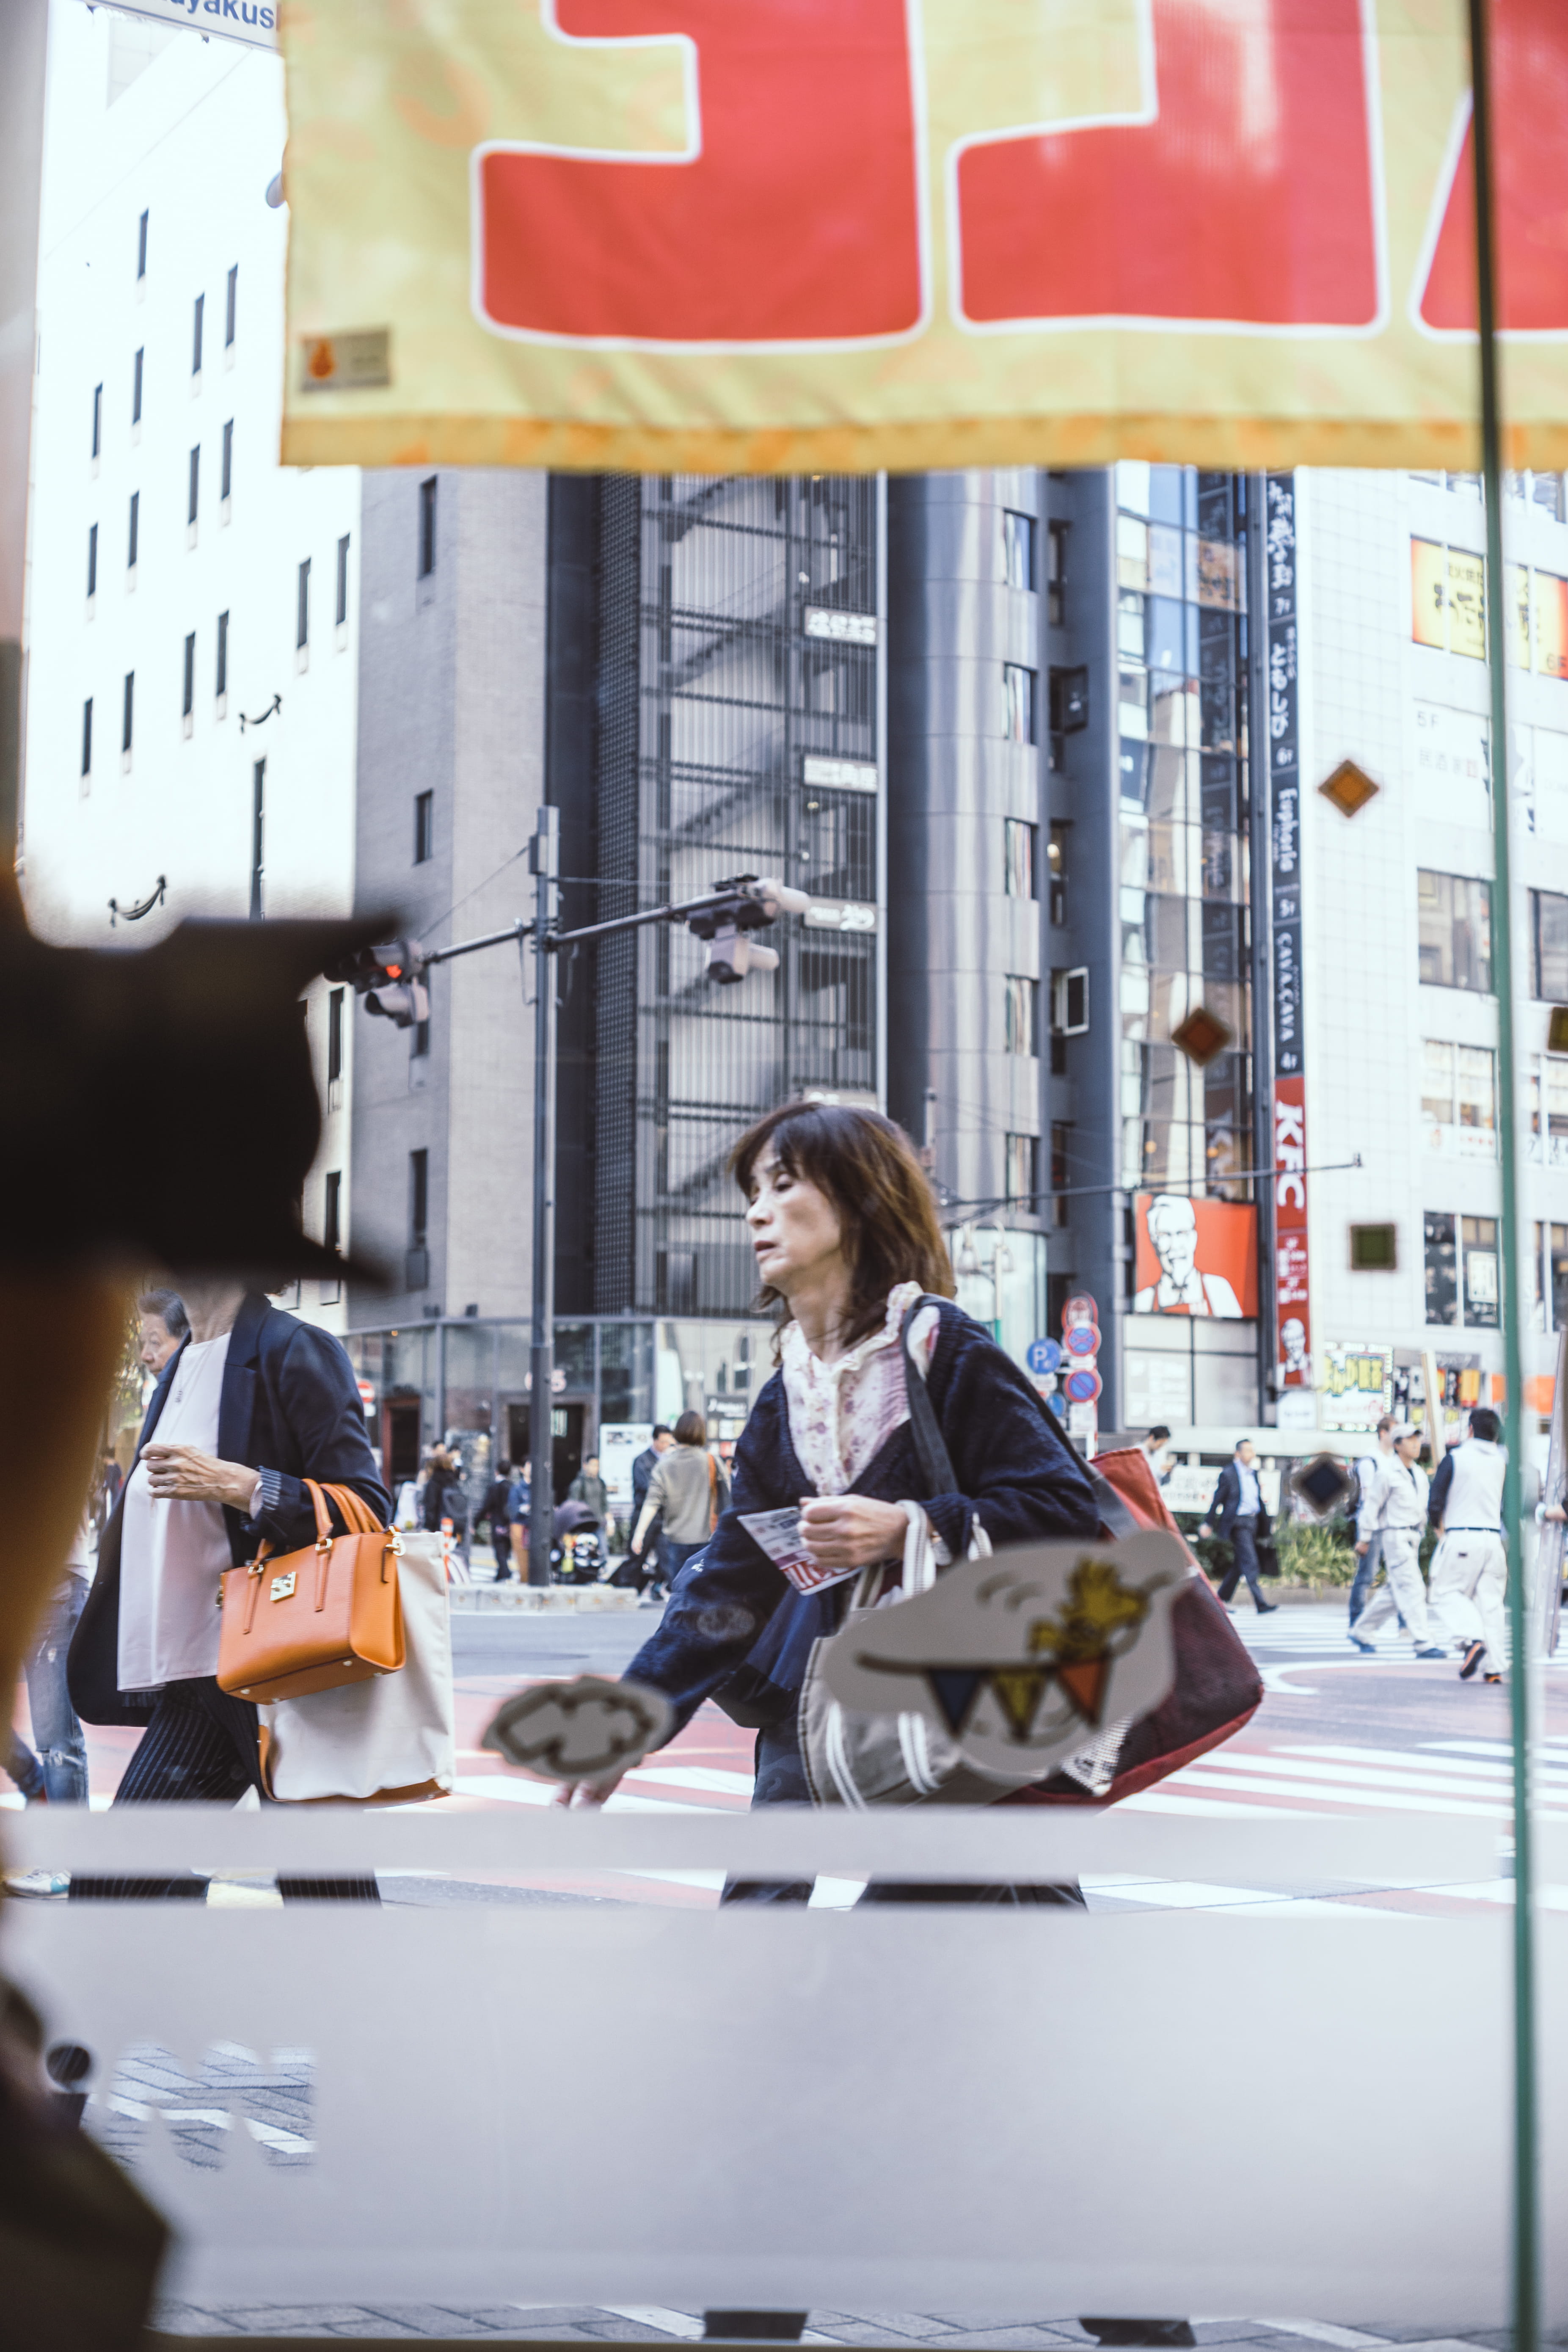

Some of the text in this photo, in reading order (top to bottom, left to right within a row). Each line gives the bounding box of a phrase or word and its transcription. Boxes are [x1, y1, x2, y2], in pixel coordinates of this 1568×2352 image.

[1276, 746, 1293, 766] 6F
[1275, 1099, 1306, 1210] KFC
[1033, 1346, 1047, 1370] P
